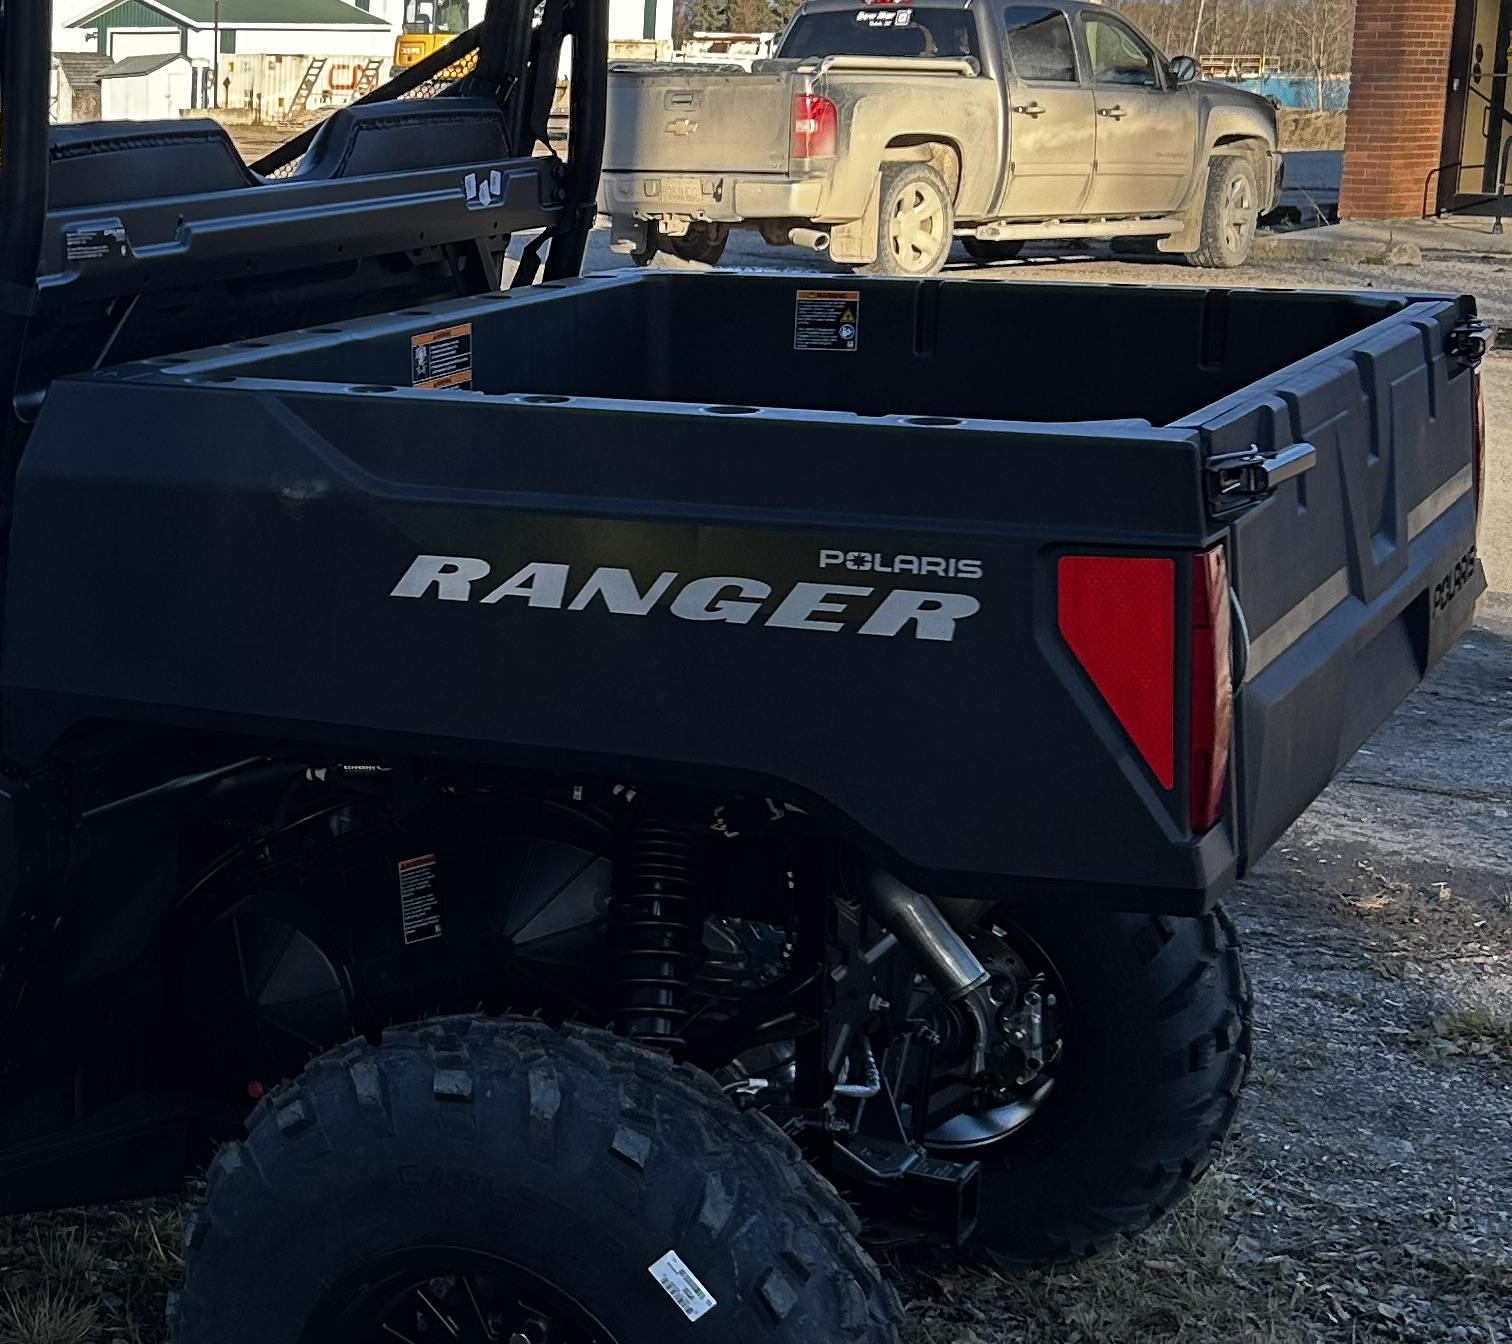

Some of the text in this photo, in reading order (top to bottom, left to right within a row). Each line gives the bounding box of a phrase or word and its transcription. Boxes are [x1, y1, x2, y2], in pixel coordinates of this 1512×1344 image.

[389, 554, 981, 642] RANGER
[819, 549, 984, 580] POLARIS
[1431, 545, 1475, 619] POLARIS
